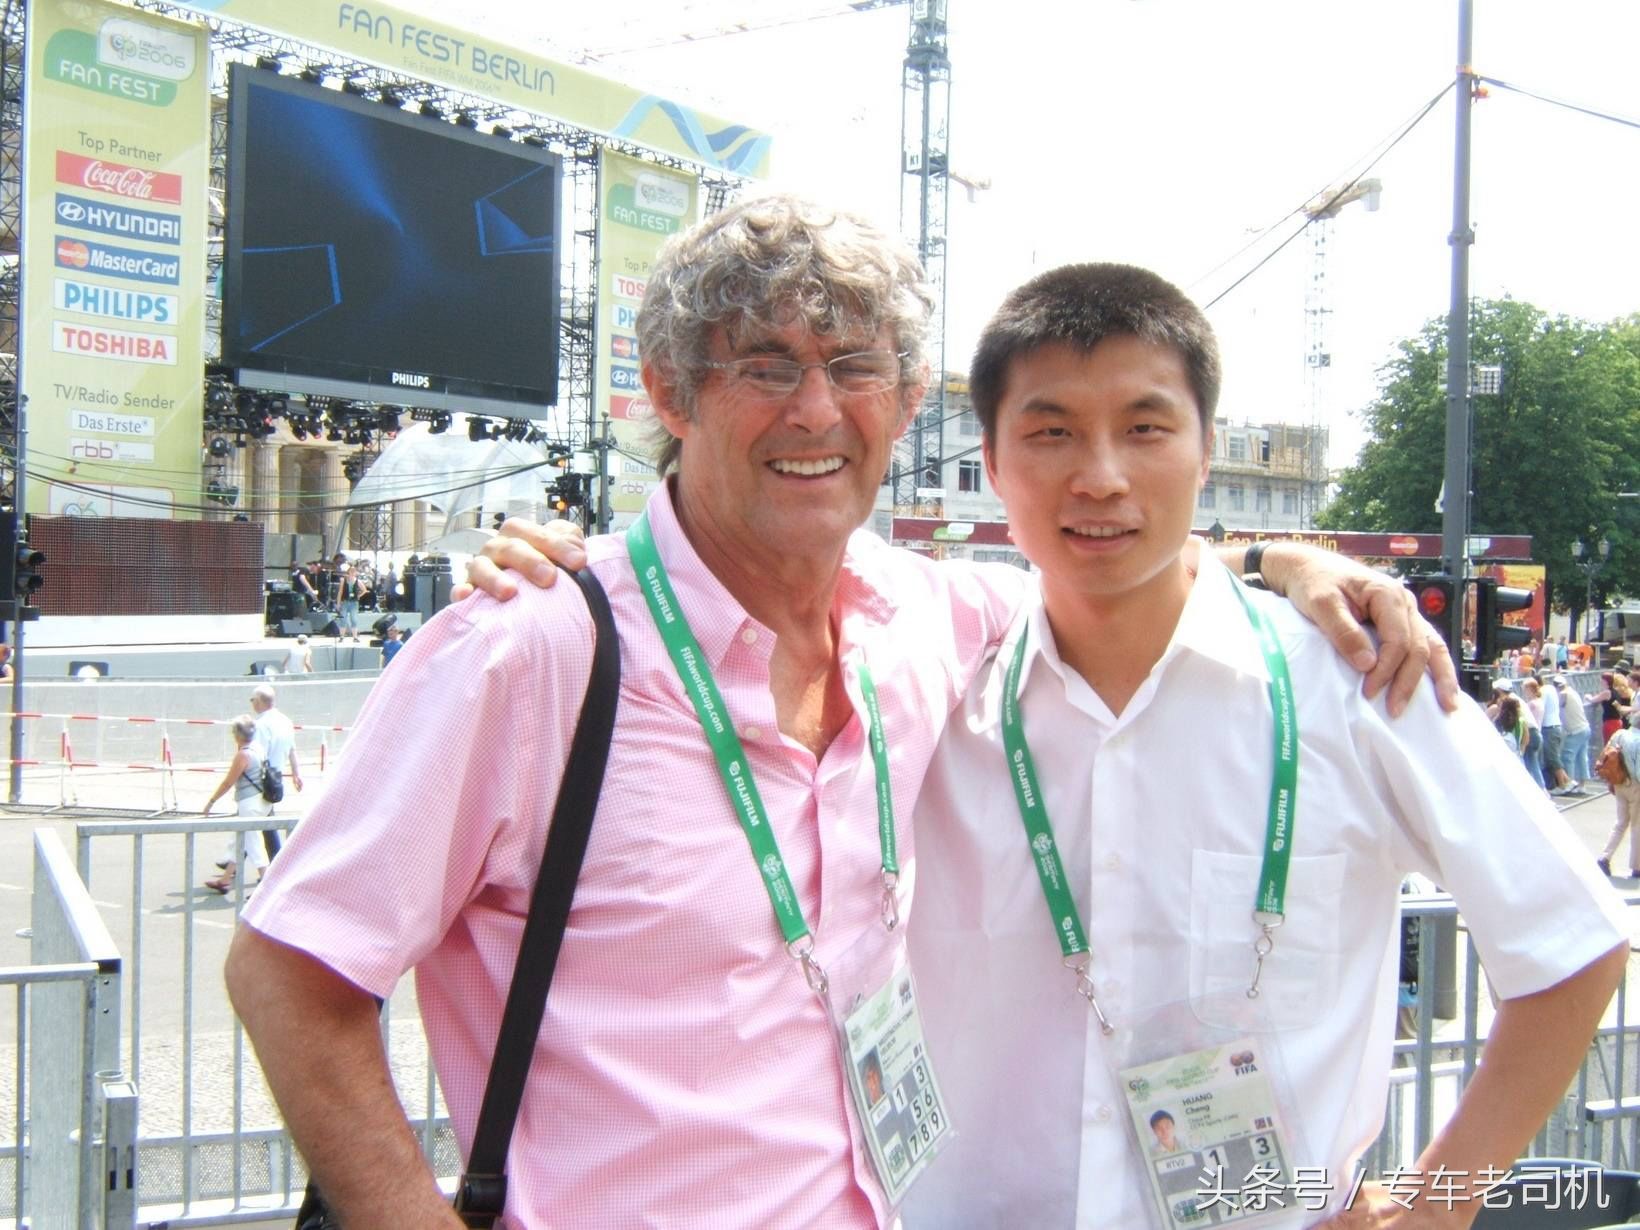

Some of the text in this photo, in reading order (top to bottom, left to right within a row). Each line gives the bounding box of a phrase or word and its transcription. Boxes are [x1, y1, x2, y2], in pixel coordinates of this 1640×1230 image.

[138, 46, 187, 69] 2006
[338, 3, 555, 97] FAN FEST BERLIN
[60, 59, 161, 101] FAN FEST
[78, 131, 163, 163] Top Partner
[88, 206, 180, 239] HYUNDAI
[613, 206, 671, 232] FAN FEST
[90, 248, 178, 278] MasterCard
[624, 257, 639, 272] Top
[64, 282, 169, 322] PHILIPS
[62, 327, 168, 360] TOSHIBA
[391, 371, 431, 388] PHILIPS
[53, 383, 176, 409] TV/Radio Sender
[78, 414, 143, 434] Das Erste
[72, 440, 113, 459] rbb
[649, 578, 676, 624] FUJIFILM
[680, 646, 724, 733] FIFAworldcup.com
[1276, 677, 1292, 761] FIFAworldcup.com
[1016, 762, 1036, 809] FUJIFILM
[733, 775, 760, 827] FUJIFILM
[1275, 788, 1289, 843] FUJIFILM
[915, 1065, 926, 1084] 3
[1234, 1063, 1258, 1077] FIFA
[896, 1090, 905, 1106] 1
[924, 1088, 933, 1107] 6
[1182, 1092, 1214, 1106] HUANG
[913, 1101, 922, 1119] 5
[931, 1112, 940, 1131] 9
[920, 1123, 930, 1143] 8
[910, 1135, 919, 1156] 7
[1255, 1137, 1270, 1155] 3
[1209, 1149, 1220, 1167] 1
